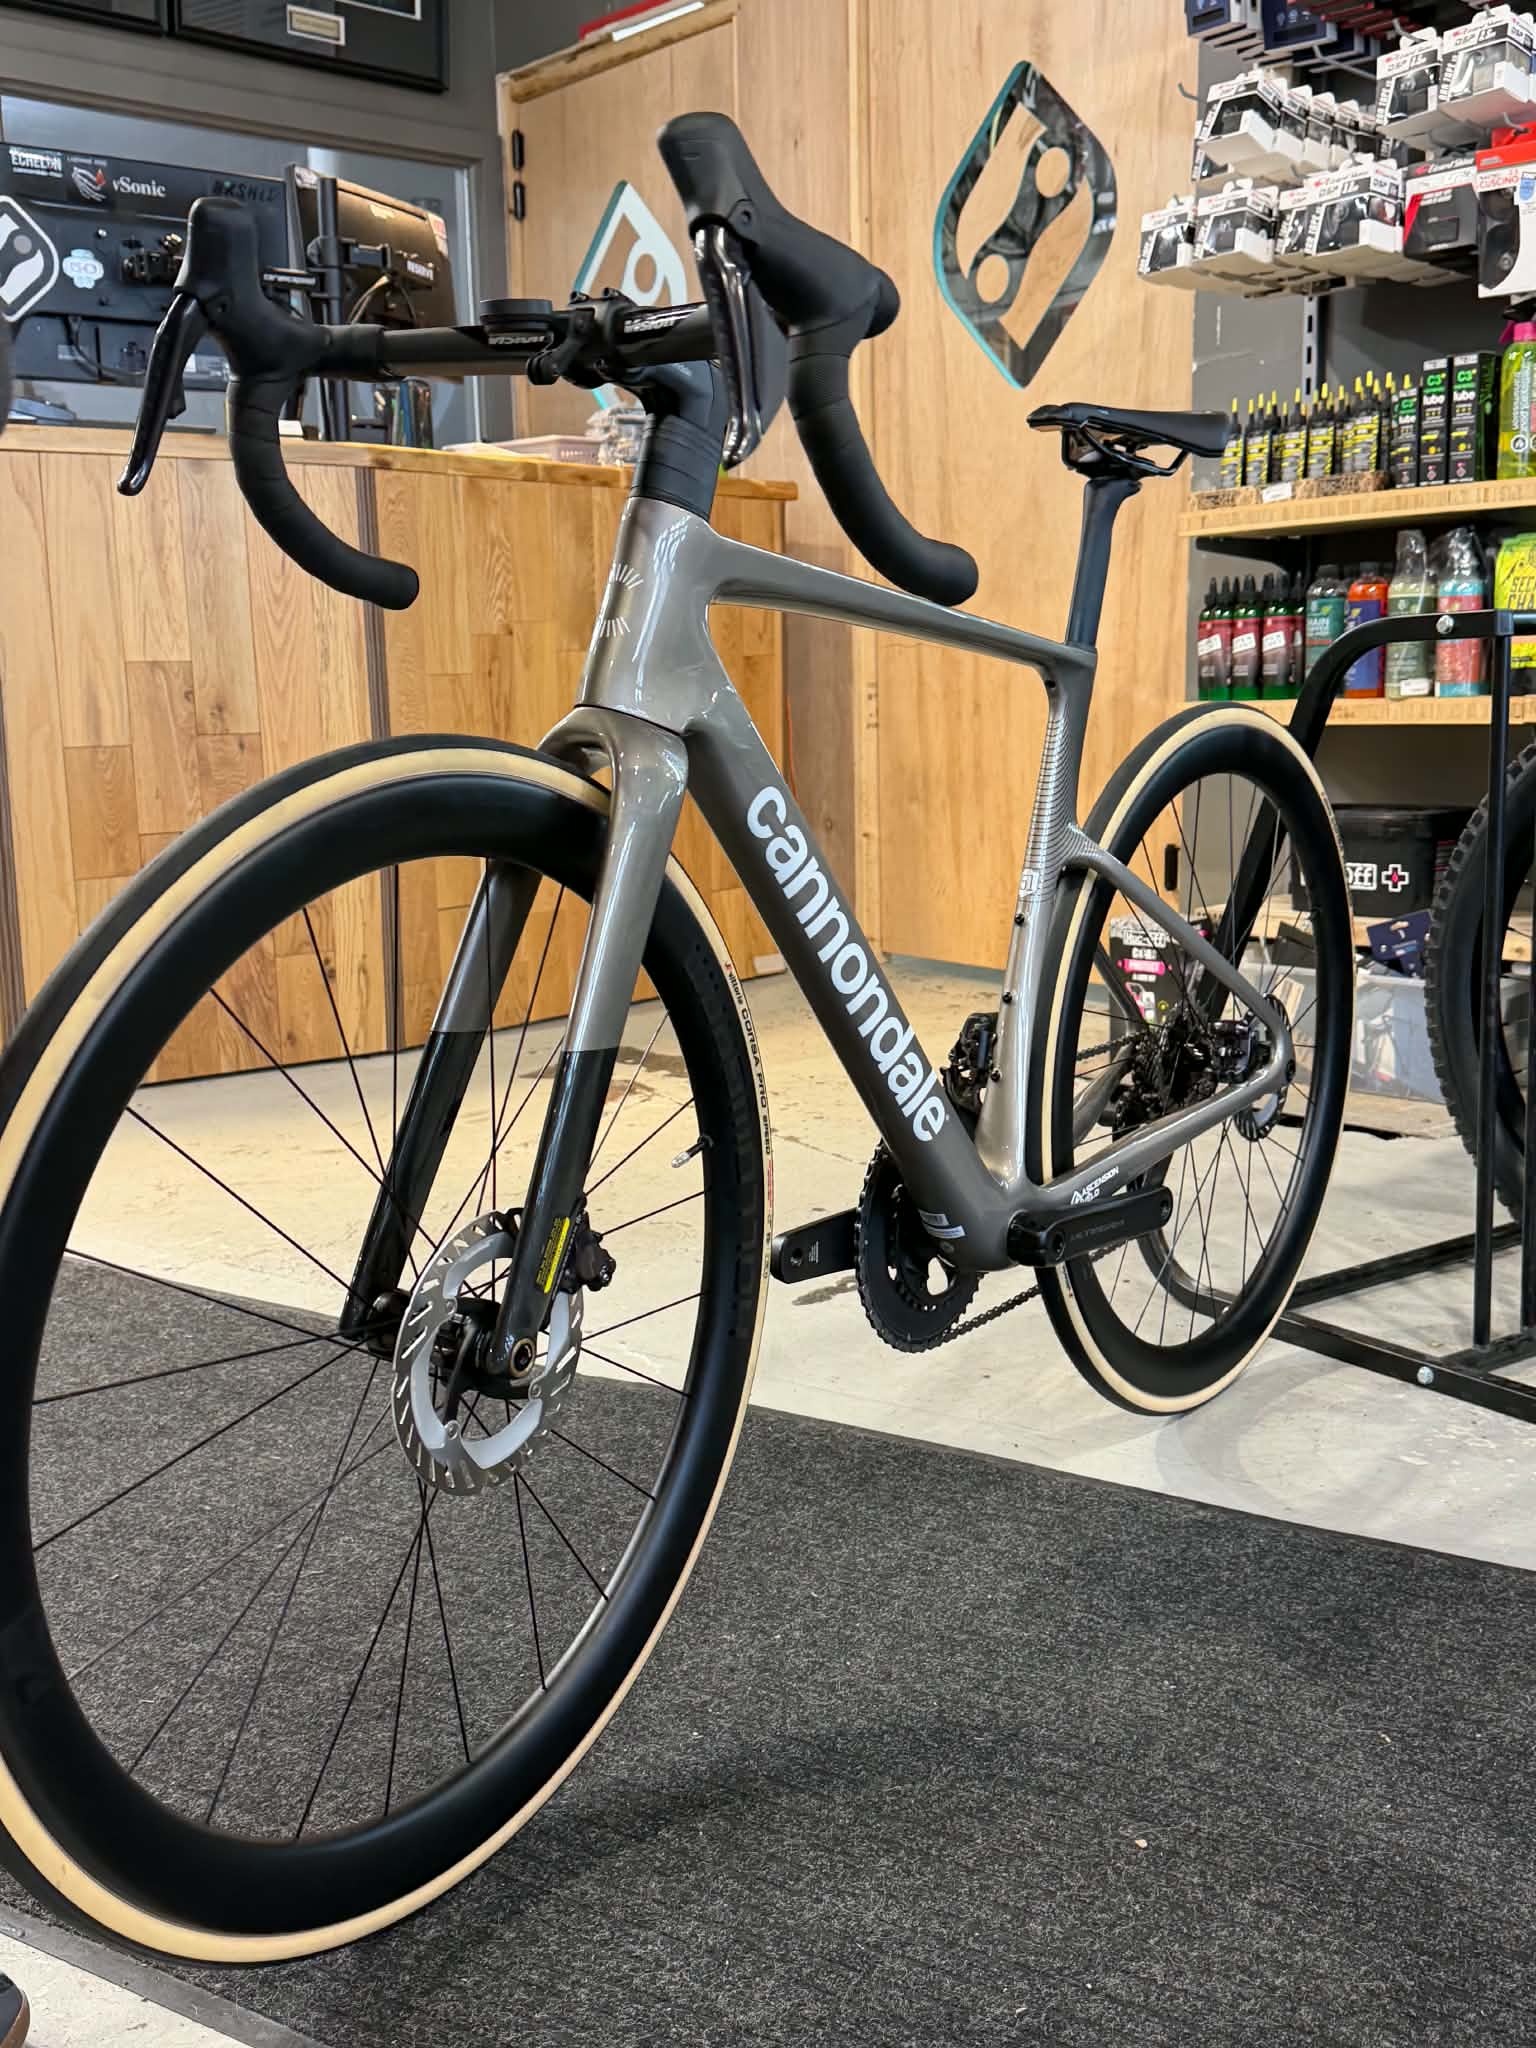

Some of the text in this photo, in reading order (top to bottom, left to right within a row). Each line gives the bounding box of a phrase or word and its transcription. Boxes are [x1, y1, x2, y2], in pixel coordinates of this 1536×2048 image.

[1423, 394, 1446, 405] lube
[1453, 390, 1476, 401] lube
[747, 786, 946, 1142] cannondale
[741, 1007, 760, 1067] CORSA
[756, 1072, 768, 1109] PRO
[1082, 1166, 1119, 1196] ASCENSION
